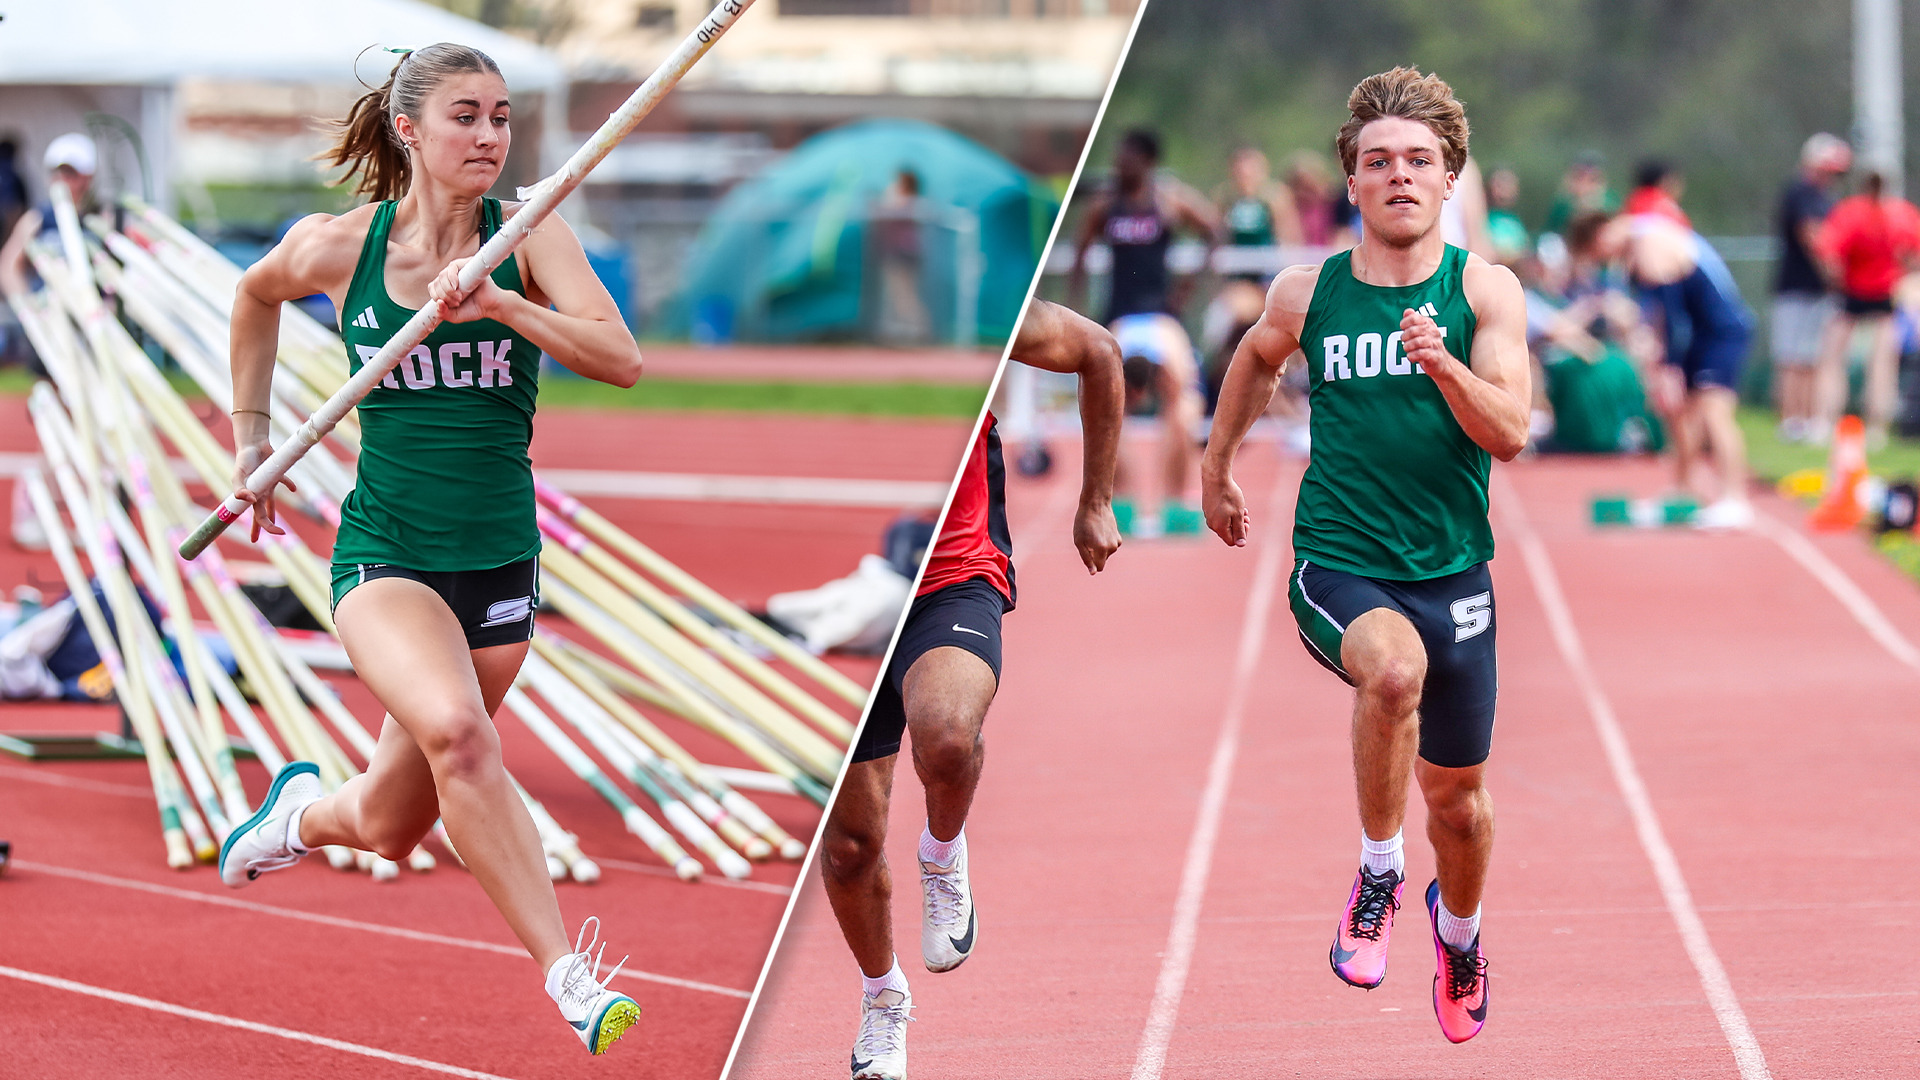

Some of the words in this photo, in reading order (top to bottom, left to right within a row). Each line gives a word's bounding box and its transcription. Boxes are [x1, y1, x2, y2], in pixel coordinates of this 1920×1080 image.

[697, 18, 724, 44] 140
[1323, 326, 1448, 382] ROC
[1449, 590, 1492, 644] S
